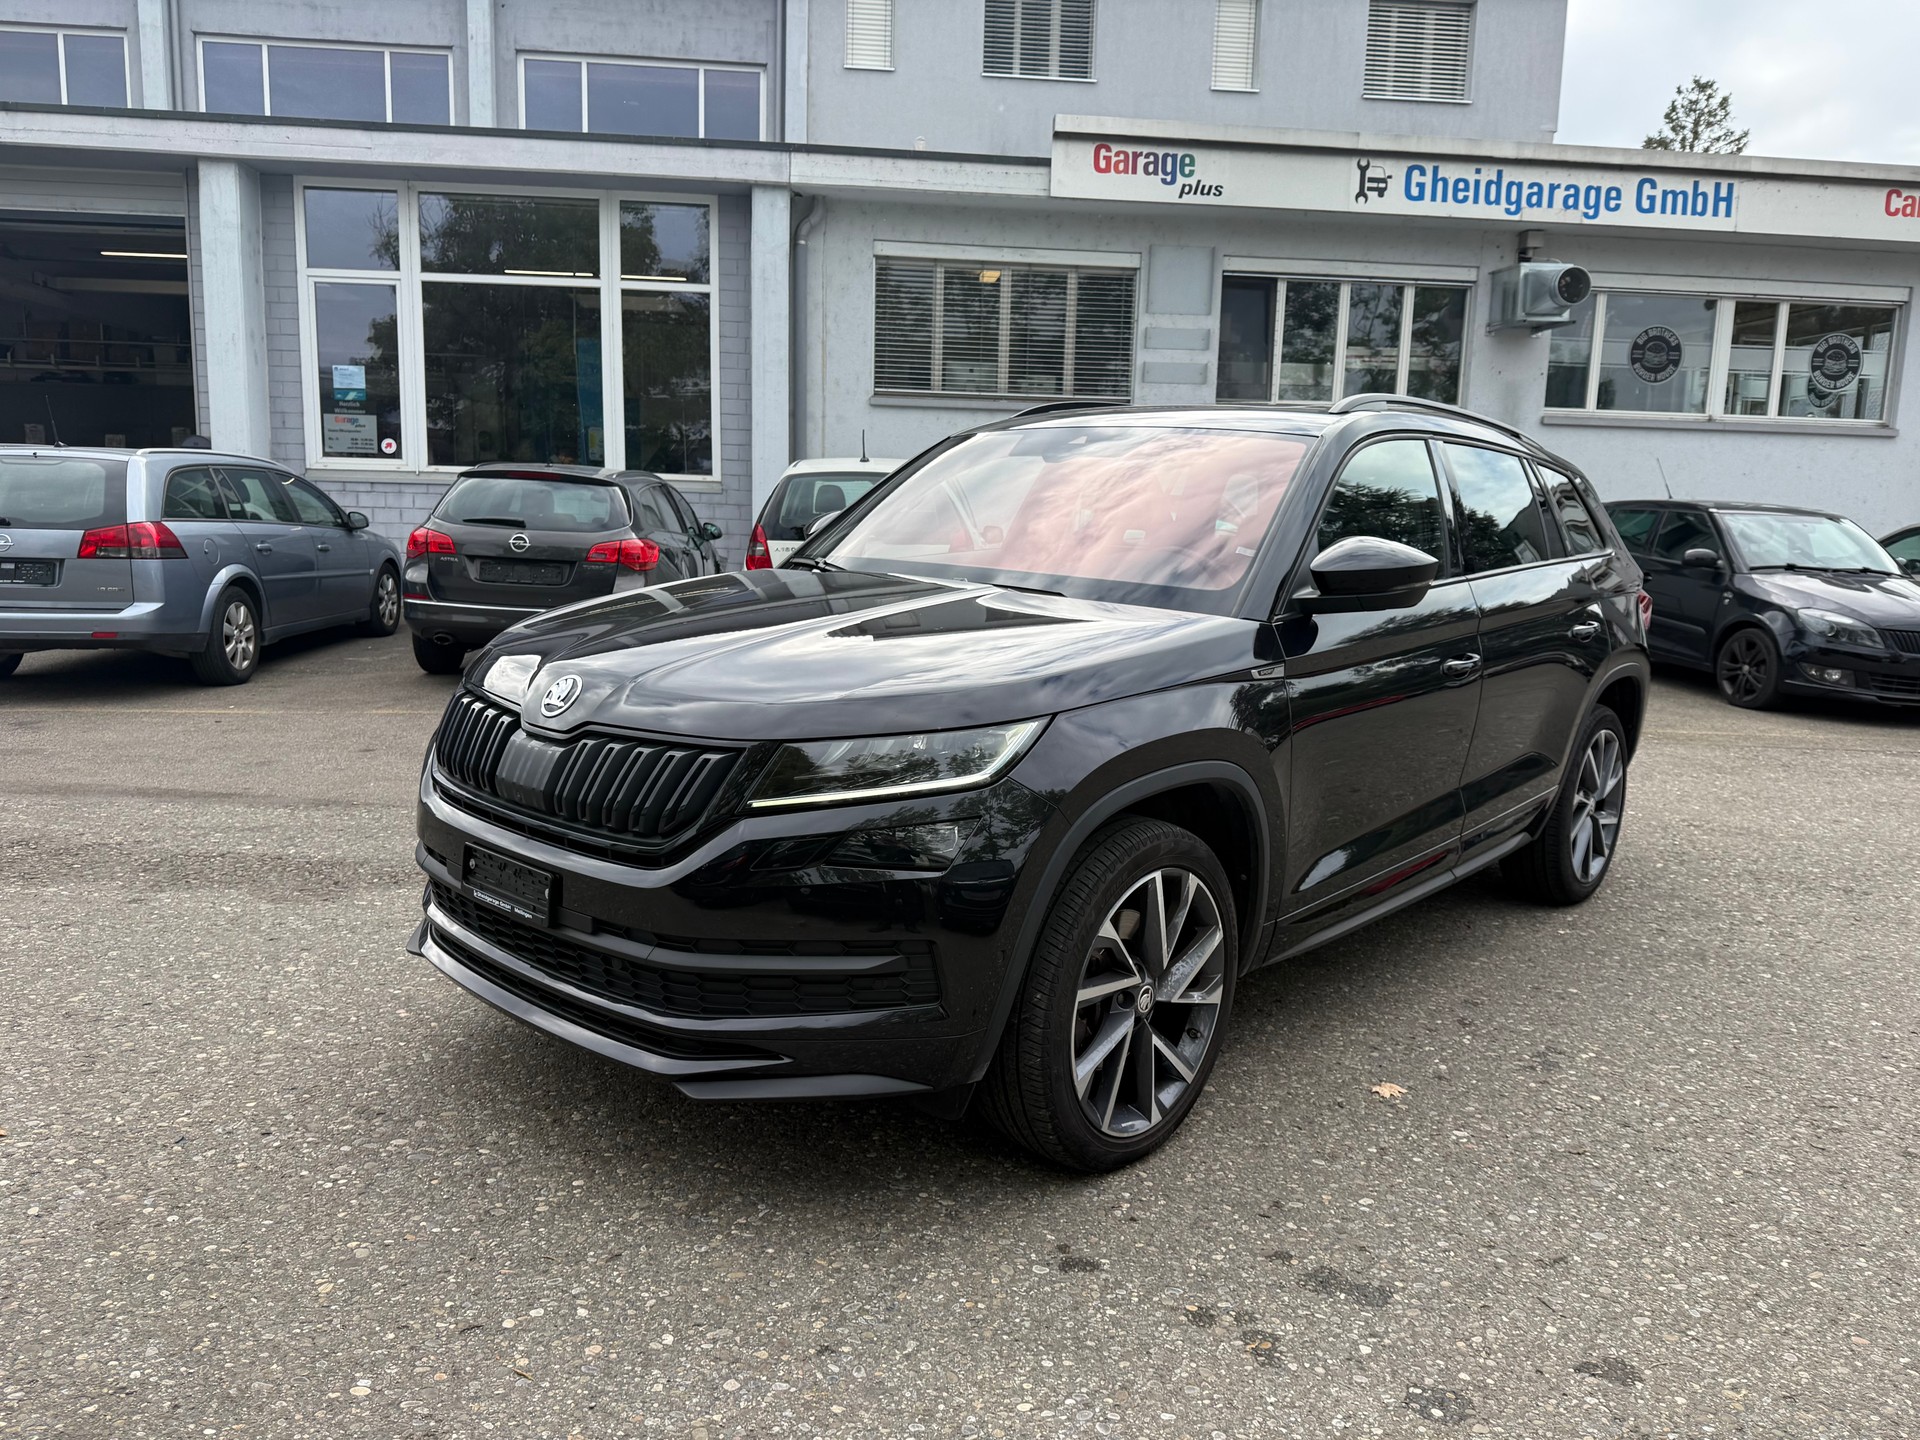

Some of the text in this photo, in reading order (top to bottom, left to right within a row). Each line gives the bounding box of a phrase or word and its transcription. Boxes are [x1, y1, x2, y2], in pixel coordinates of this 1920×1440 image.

[1093, 143, 1196, 186] Garage
[1178, 179, 1224, 199] plus
[1404, 163, 1735, 220] Gheidgarage GmbH
[1816, 336, 1859, 354] BIG BROTHERS
[1813, 369, 1857, 389] BURGER HOUSE
